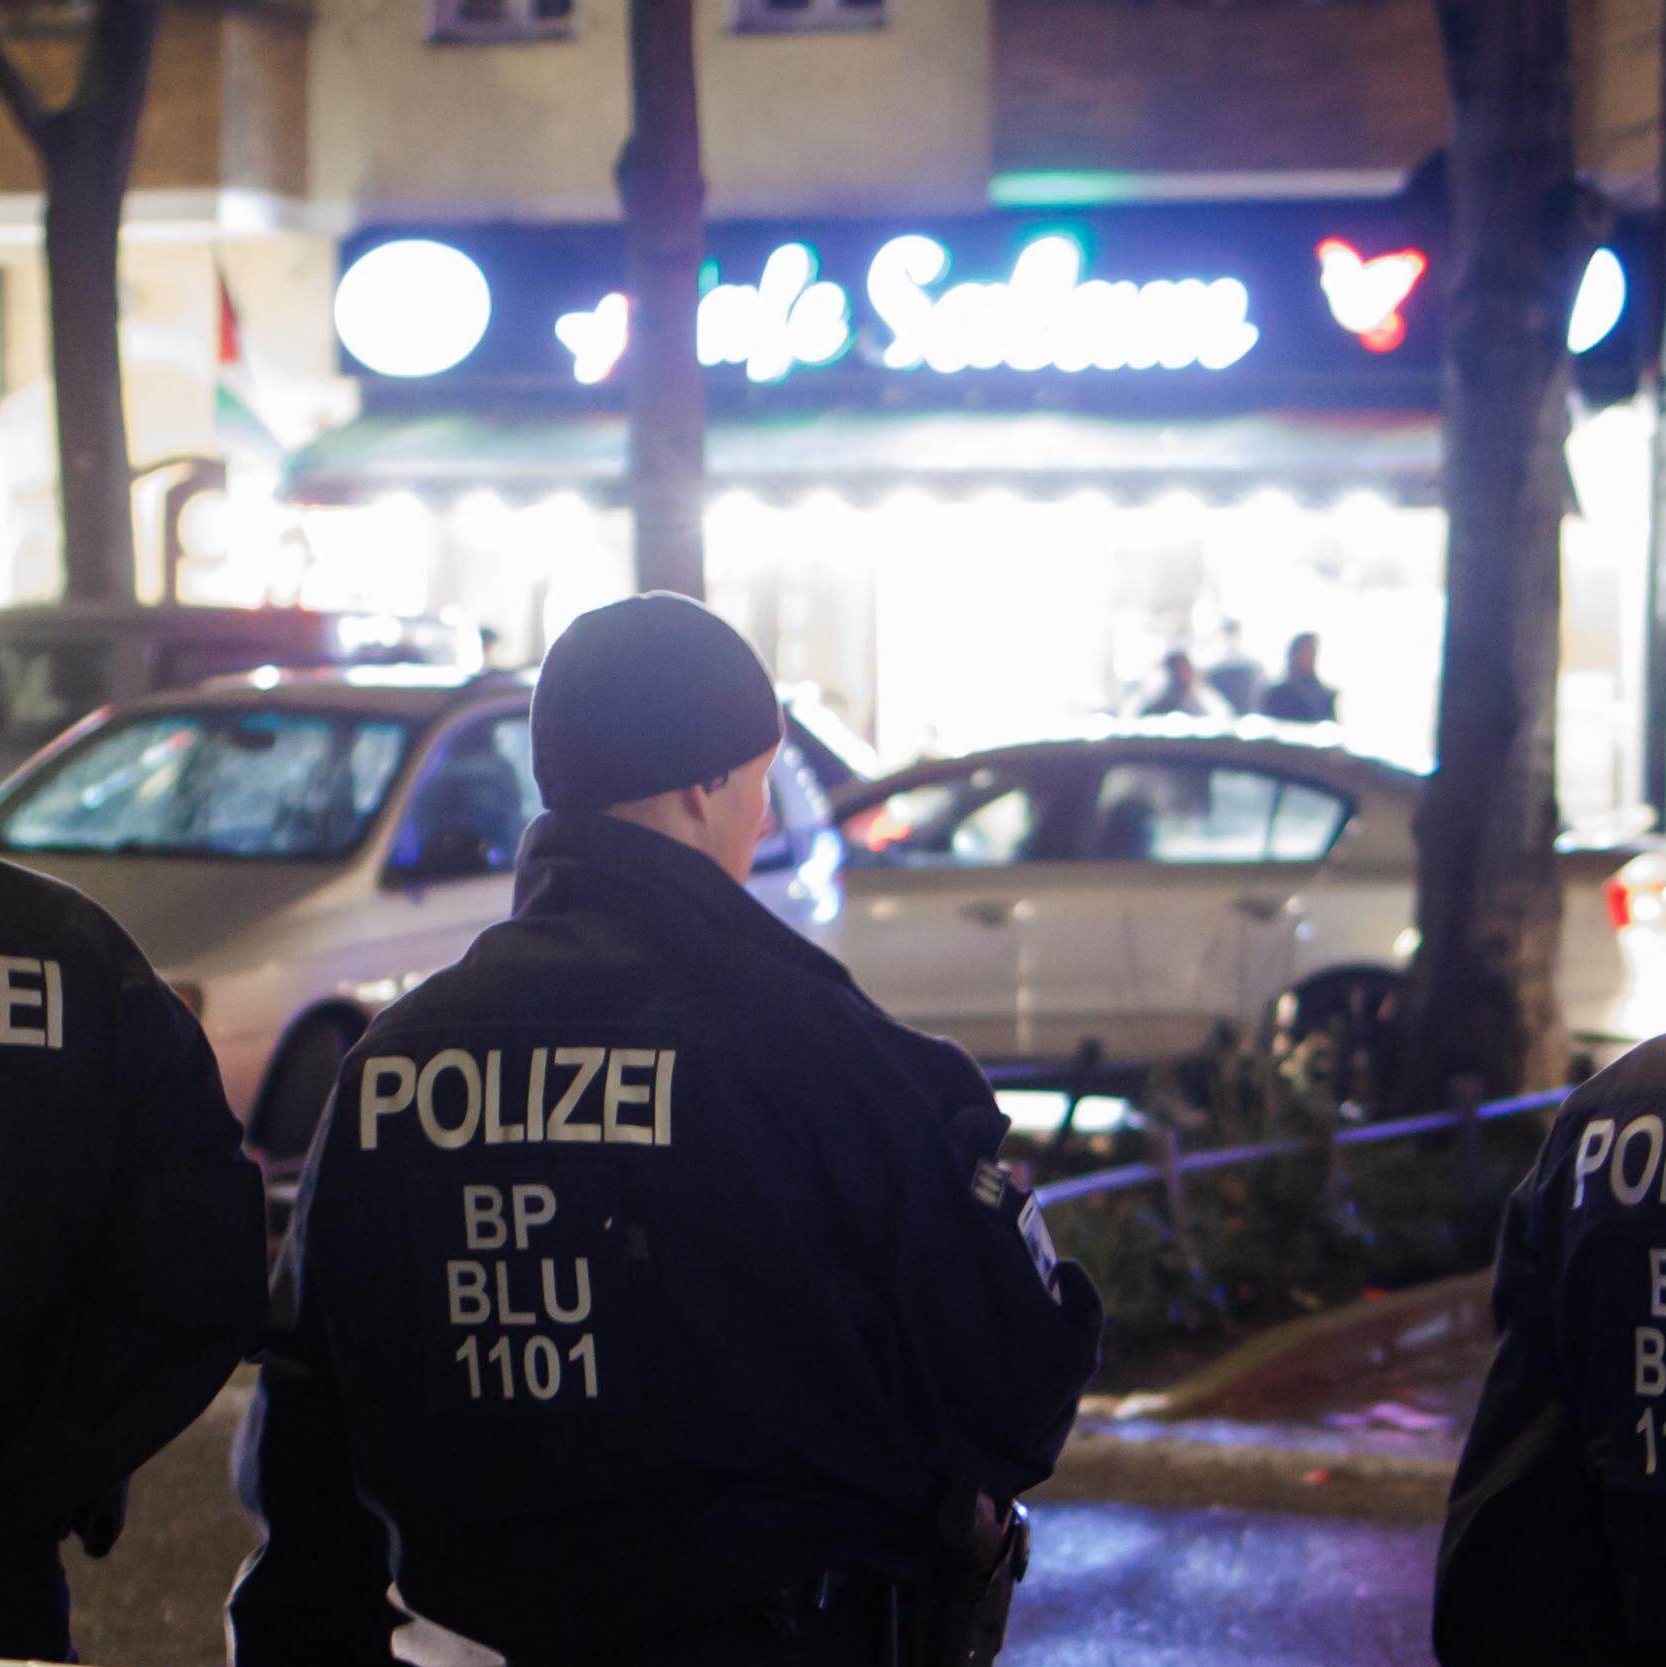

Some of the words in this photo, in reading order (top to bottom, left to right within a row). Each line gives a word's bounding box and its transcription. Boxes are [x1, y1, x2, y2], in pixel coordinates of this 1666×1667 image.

[359, 1046, 677, 1151] POLIZEI
[462, 1183, 557, 1251] BP
[446, 1256, 593, 1326] BLU
[455, 1332, 598, 1401] 1101
